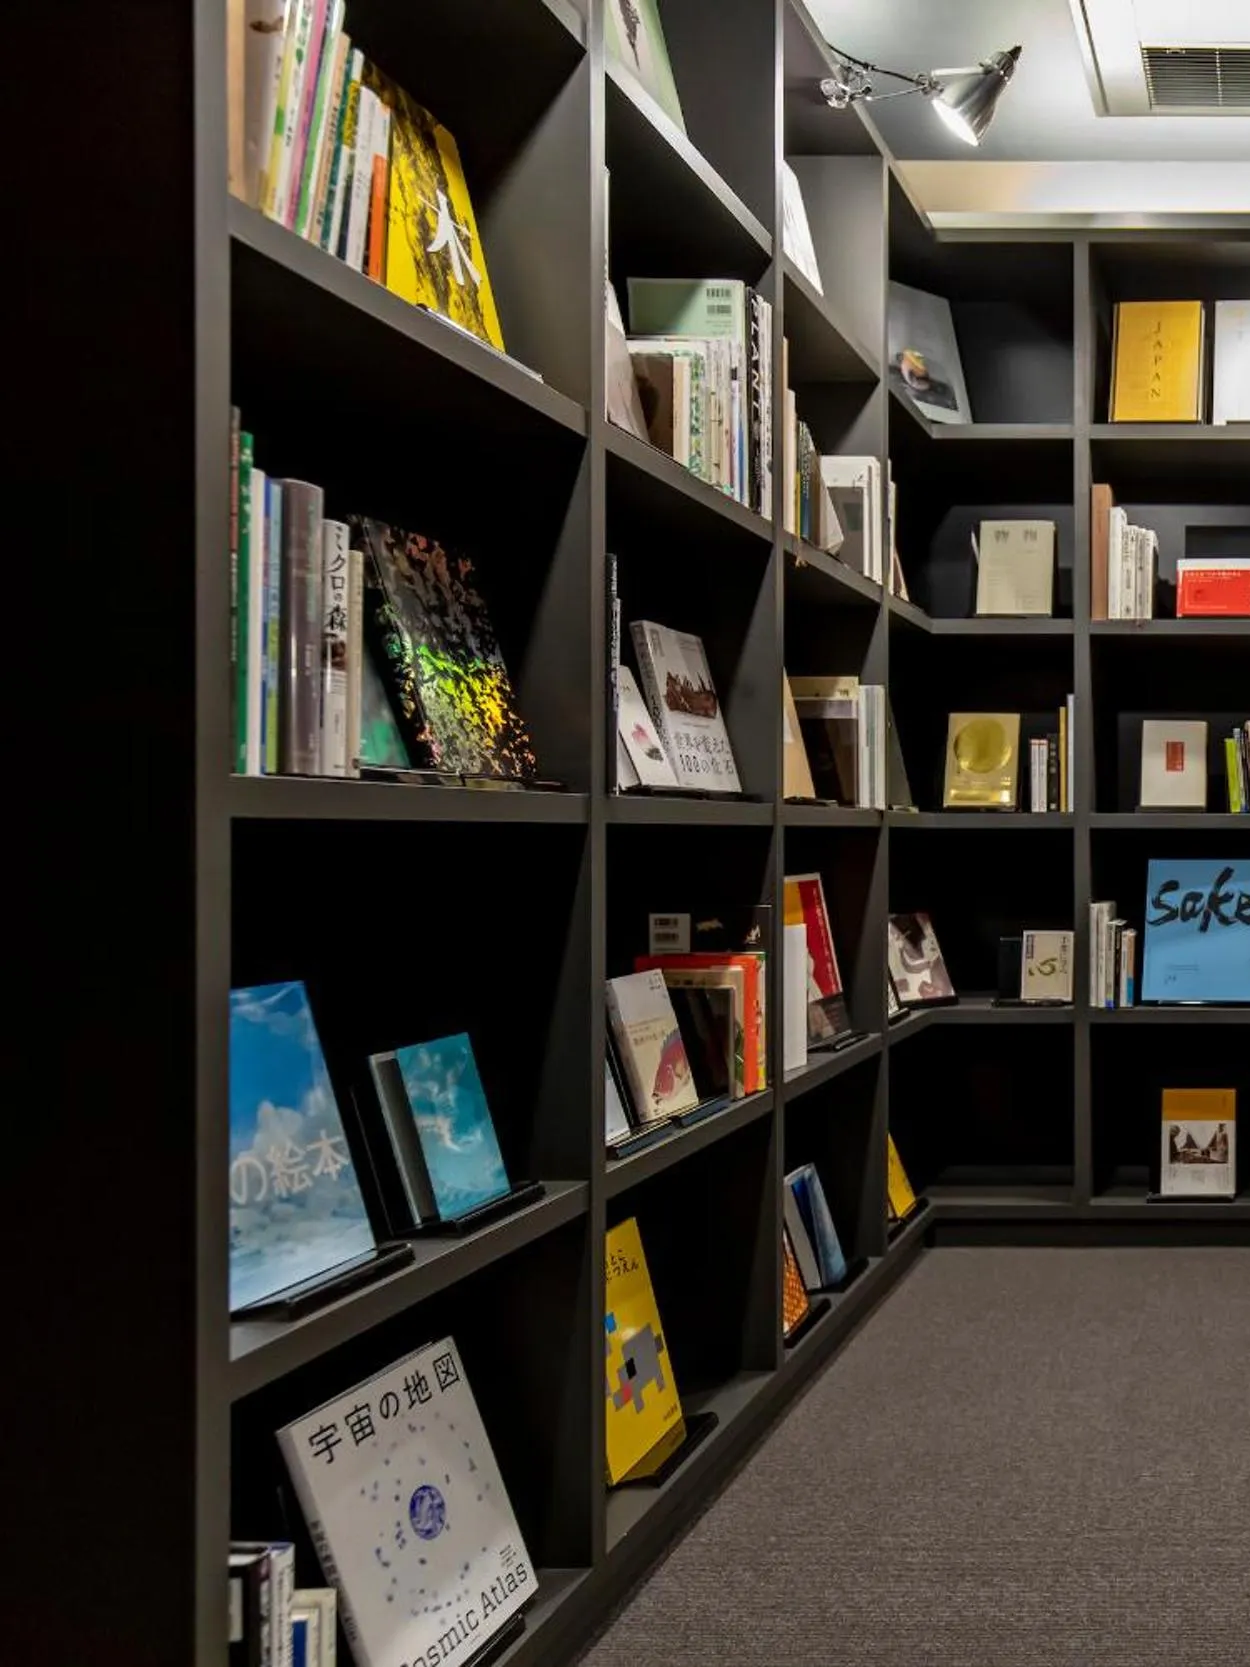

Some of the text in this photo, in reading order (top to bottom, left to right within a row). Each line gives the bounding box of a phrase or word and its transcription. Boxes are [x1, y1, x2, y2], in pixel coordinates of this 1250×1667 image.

[1152, 321, 1163, 398] JAPAN
[230, 1129, 350, 1205] の絵本
[308, 1352, 460, 1464] 宇宙の地図
[480, 1562, 528, 1619] Atlas
